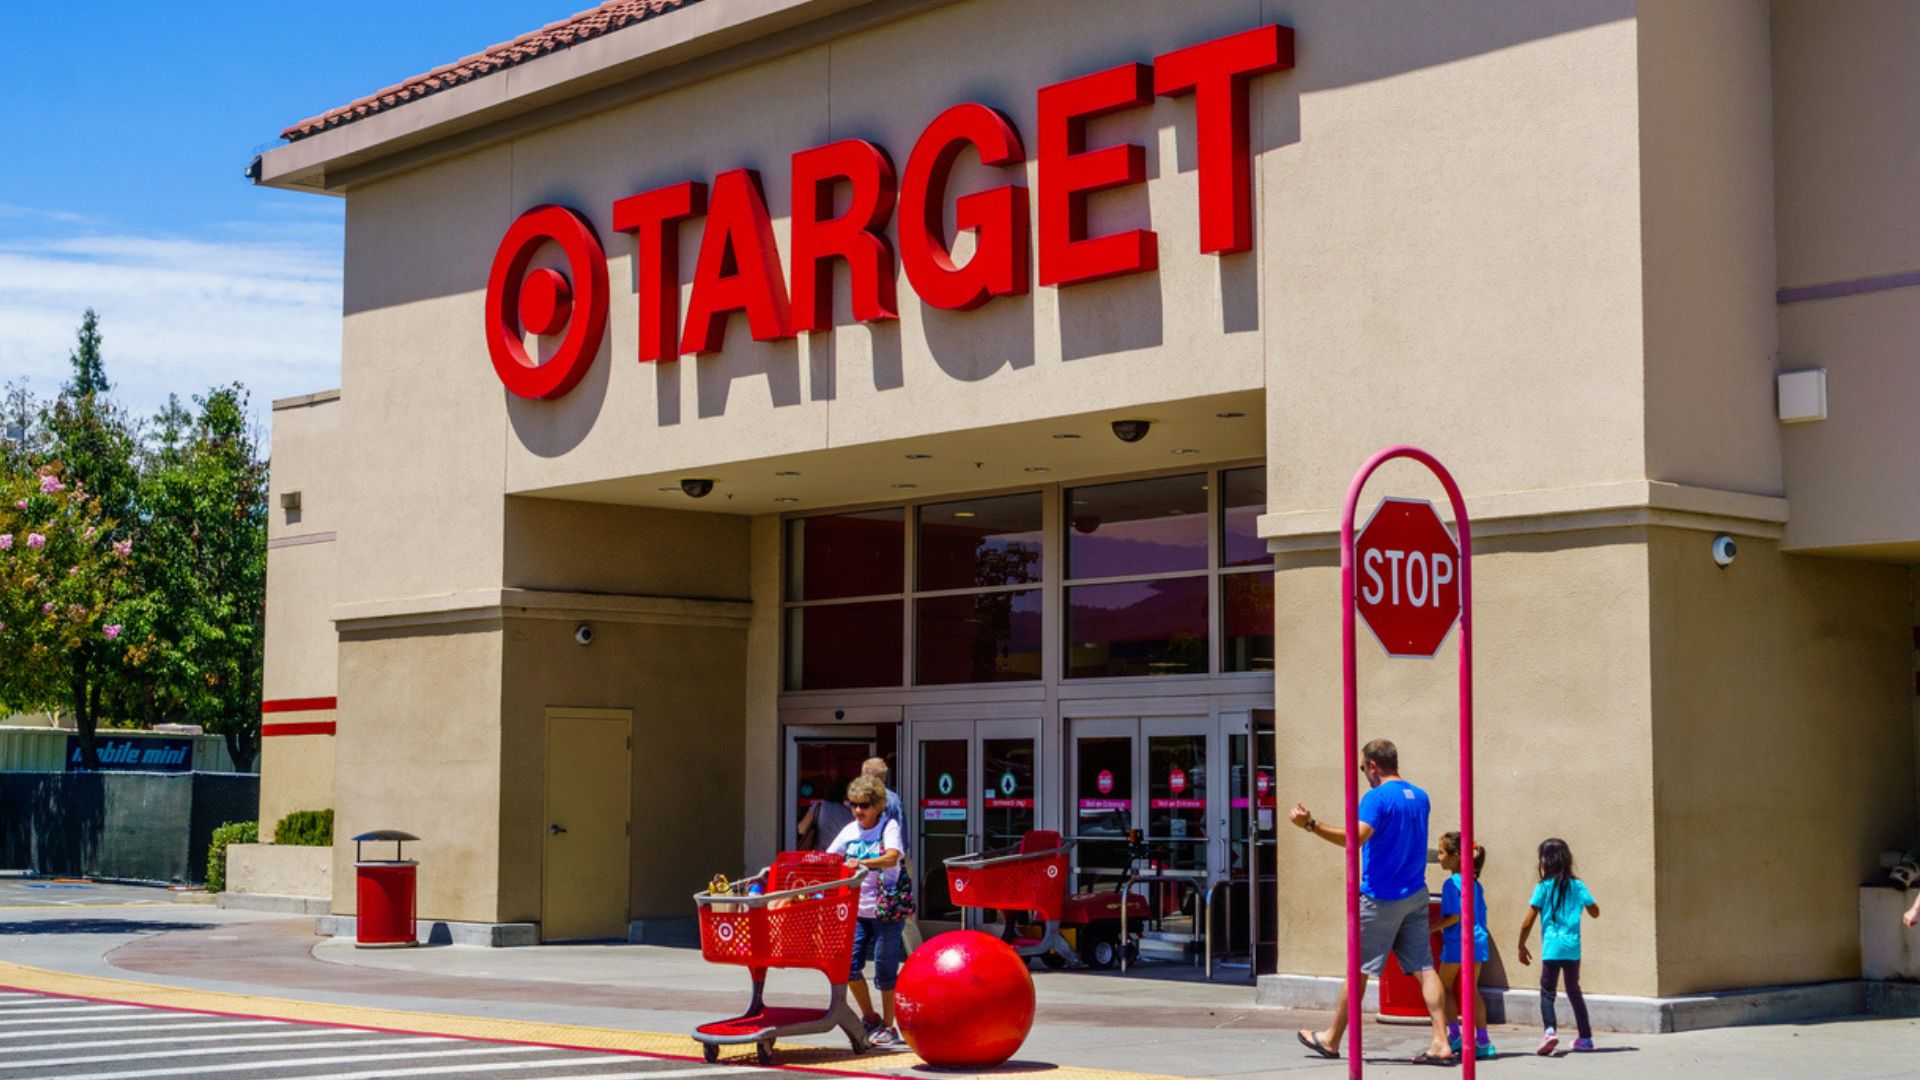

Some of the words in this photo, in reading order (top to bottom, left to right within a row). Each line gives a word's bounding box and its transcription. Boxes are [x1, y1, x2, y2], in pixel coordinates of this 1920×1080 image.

[612, 24, 1294, 362] TARGET
[1362, 548, 1453, 607] STOP
[141, 745, 188, 764] mini
